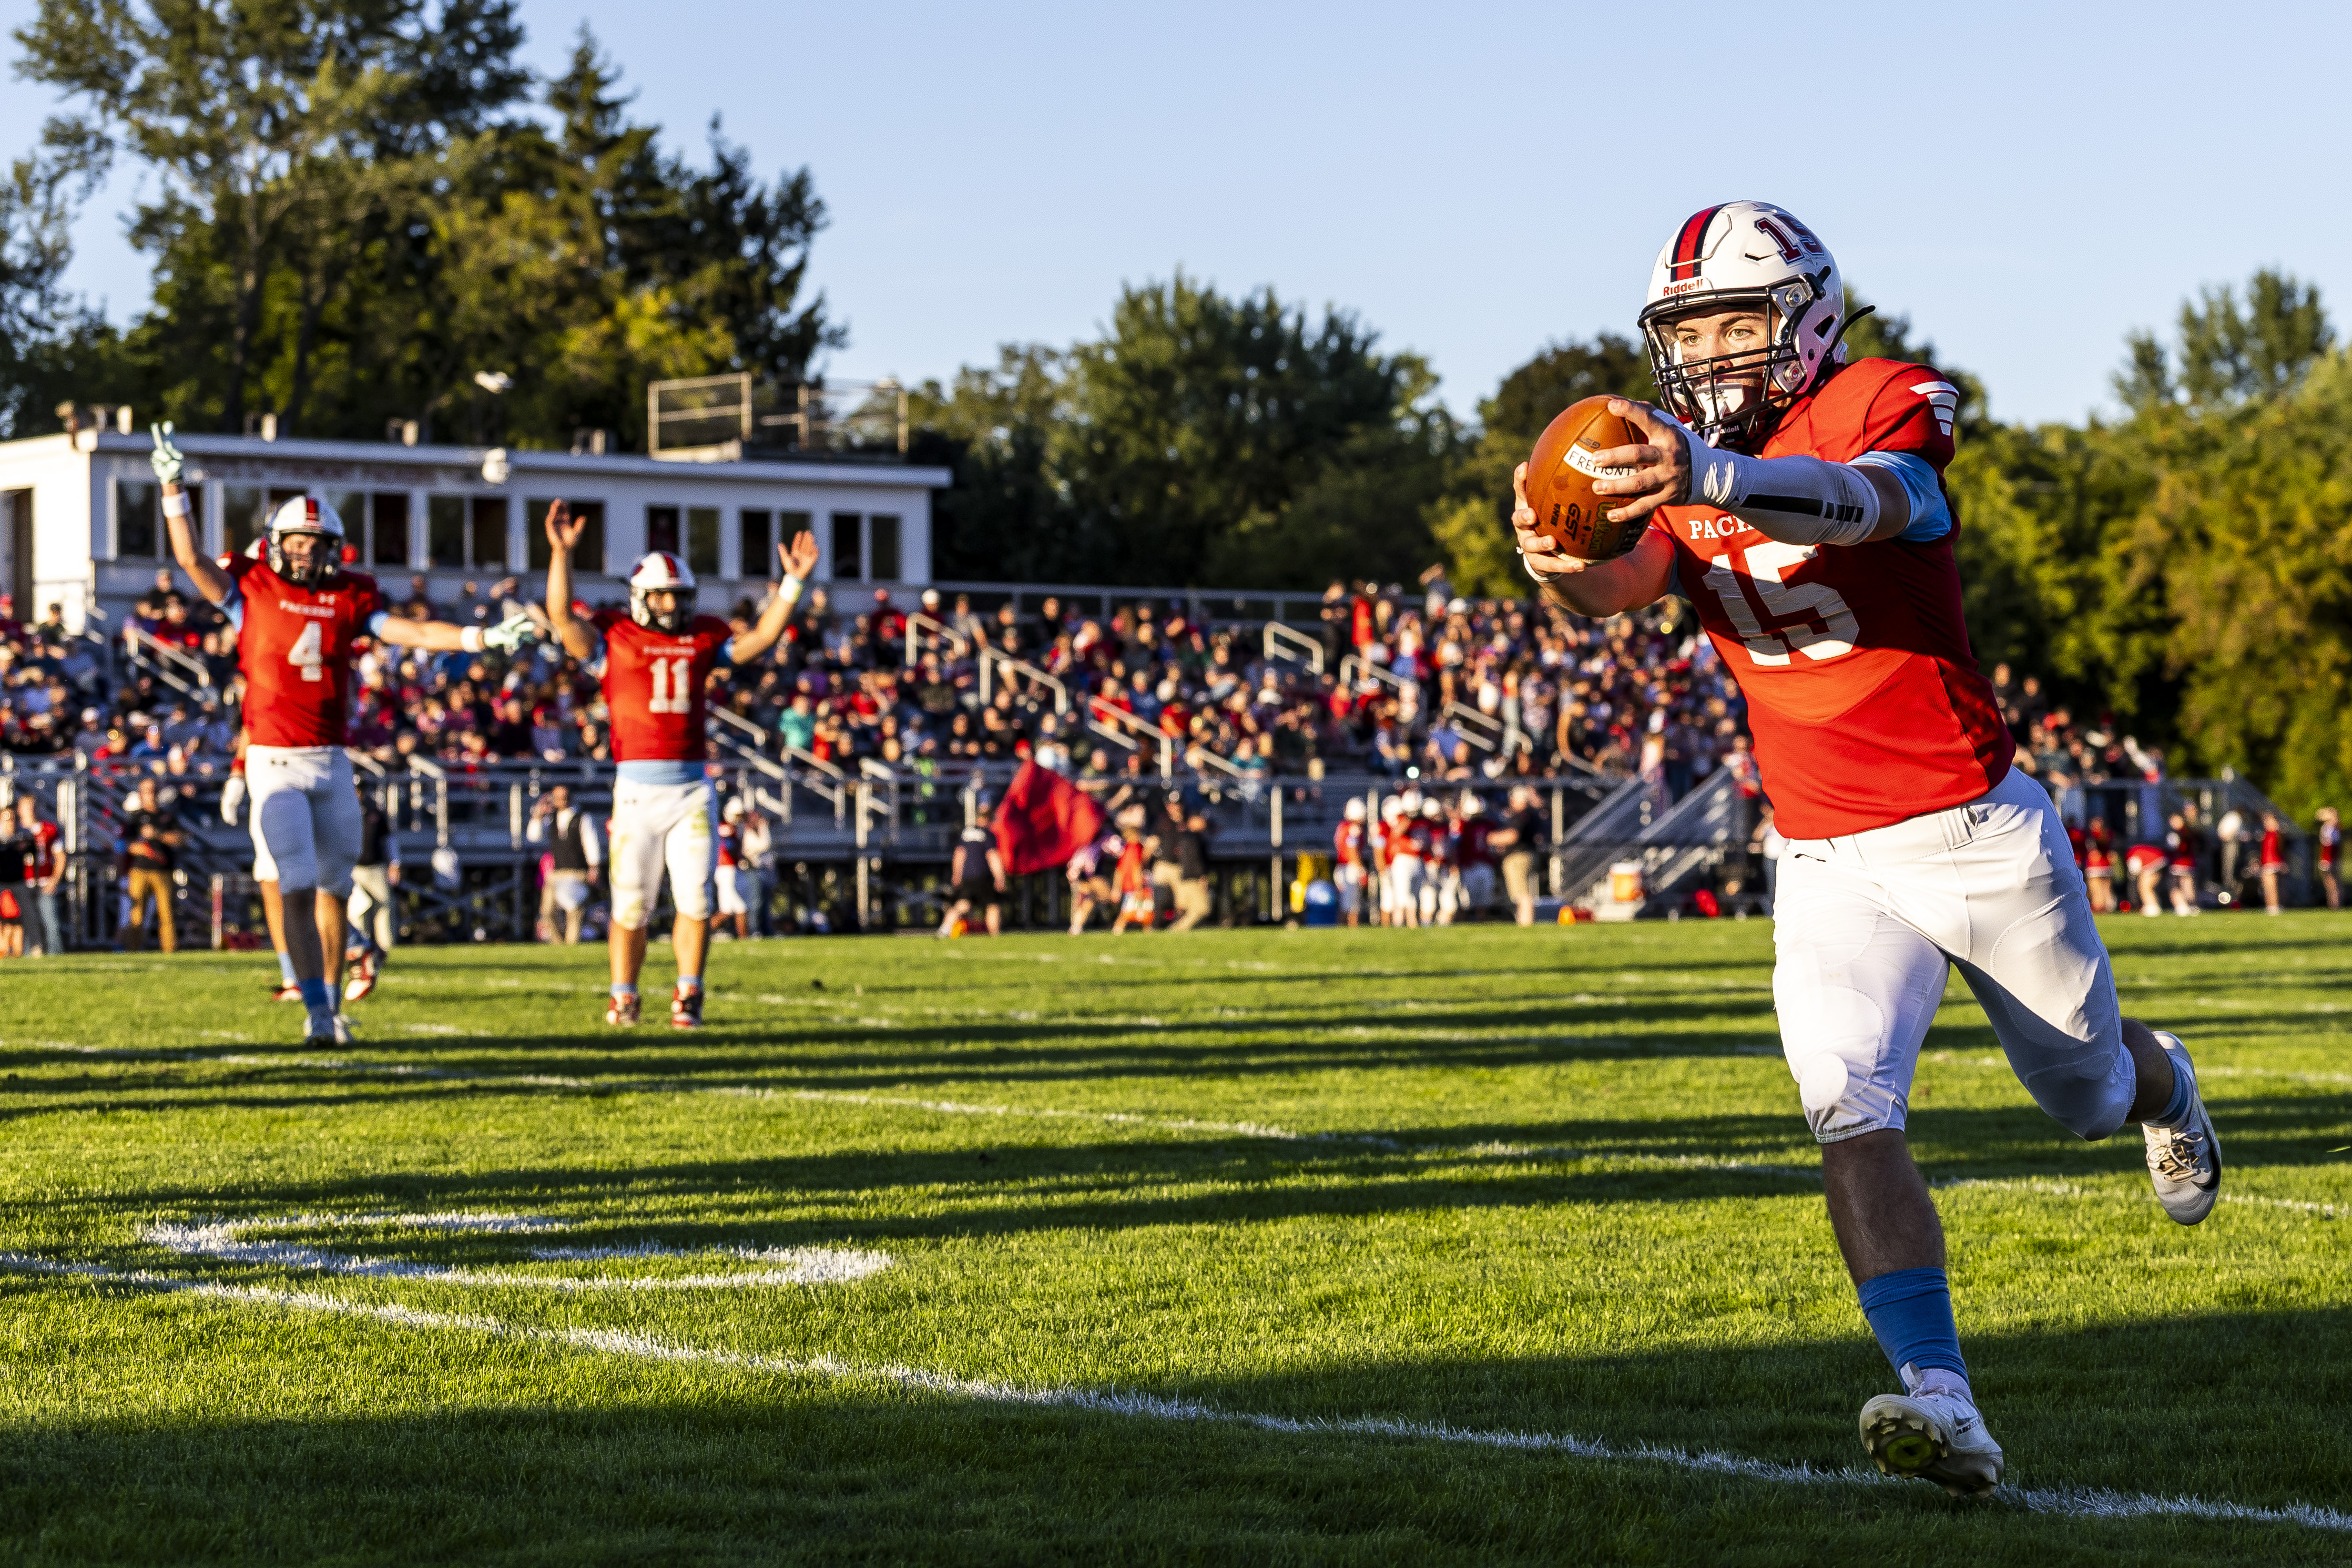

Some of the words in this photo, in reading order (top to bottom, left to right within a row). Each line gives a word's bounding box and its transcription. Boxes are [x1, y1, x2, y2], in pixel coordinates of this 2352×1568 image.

[1754, 214, 1825, 266] 15
[1663, 279, 1703, 297] Riddell
[1564, 503, 1581, 541] GST
[1702, 540, 1859, 666] 15
[287, 621, 323, 682] 4
[649, 657, 691, 714] 11
